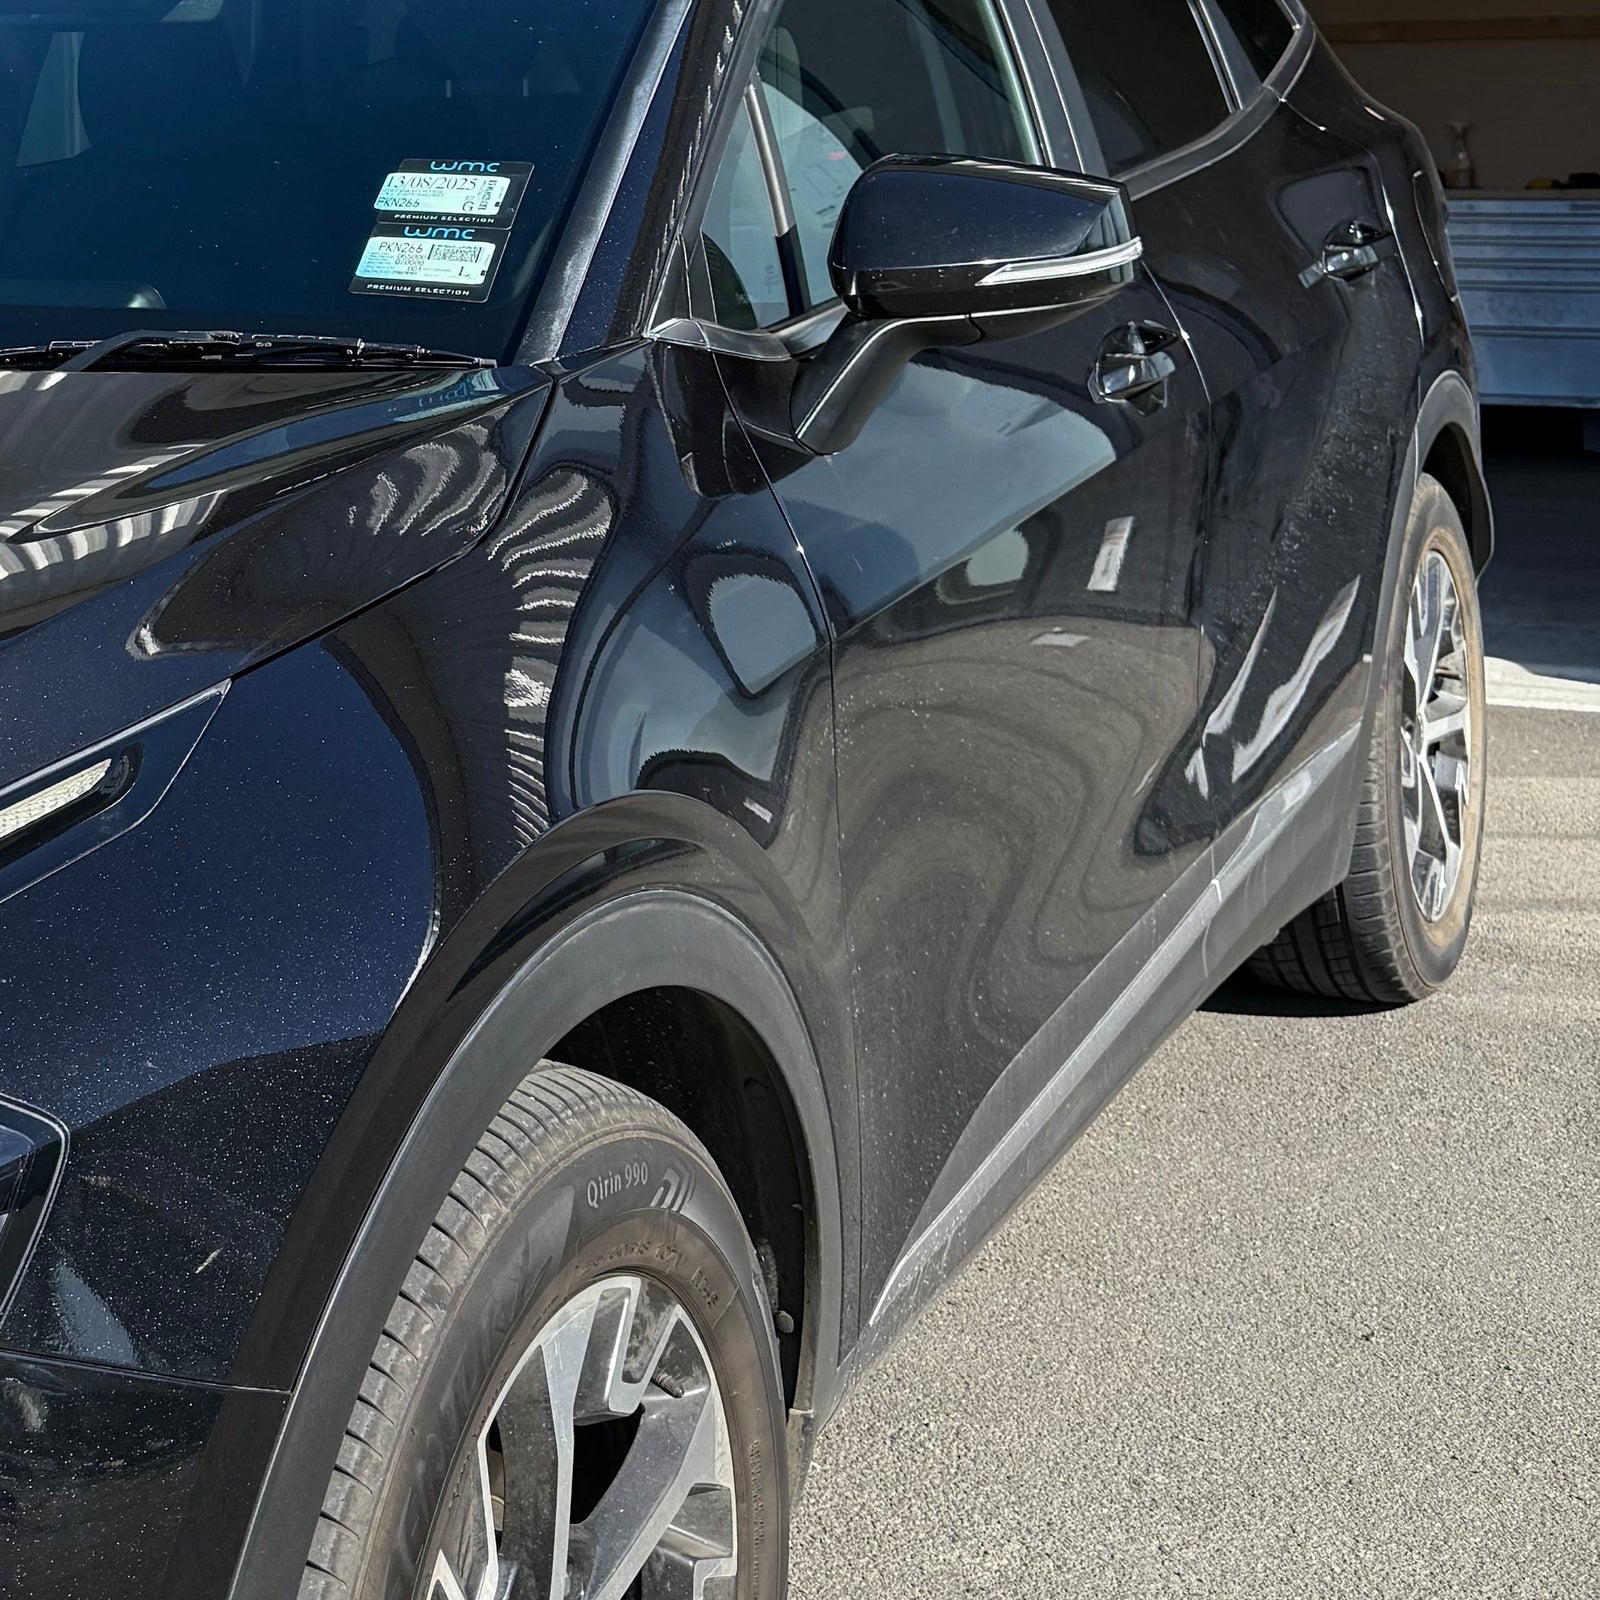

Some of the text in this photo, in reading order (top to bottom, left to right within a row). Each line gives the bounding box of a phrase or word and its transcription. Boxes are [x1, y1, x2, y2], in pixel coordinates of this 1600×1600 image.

[386, 175, 478, 192] 13/08/2025
[377, 196, 420, 209] PKN266
[441, 216, 495, 224] SELECTION
[378, 241, 424, 254] PKN266
[367, 283, 470, 296] PREMIUM SELECTION
[586, 1161, 649, 1209] Qirin 990
